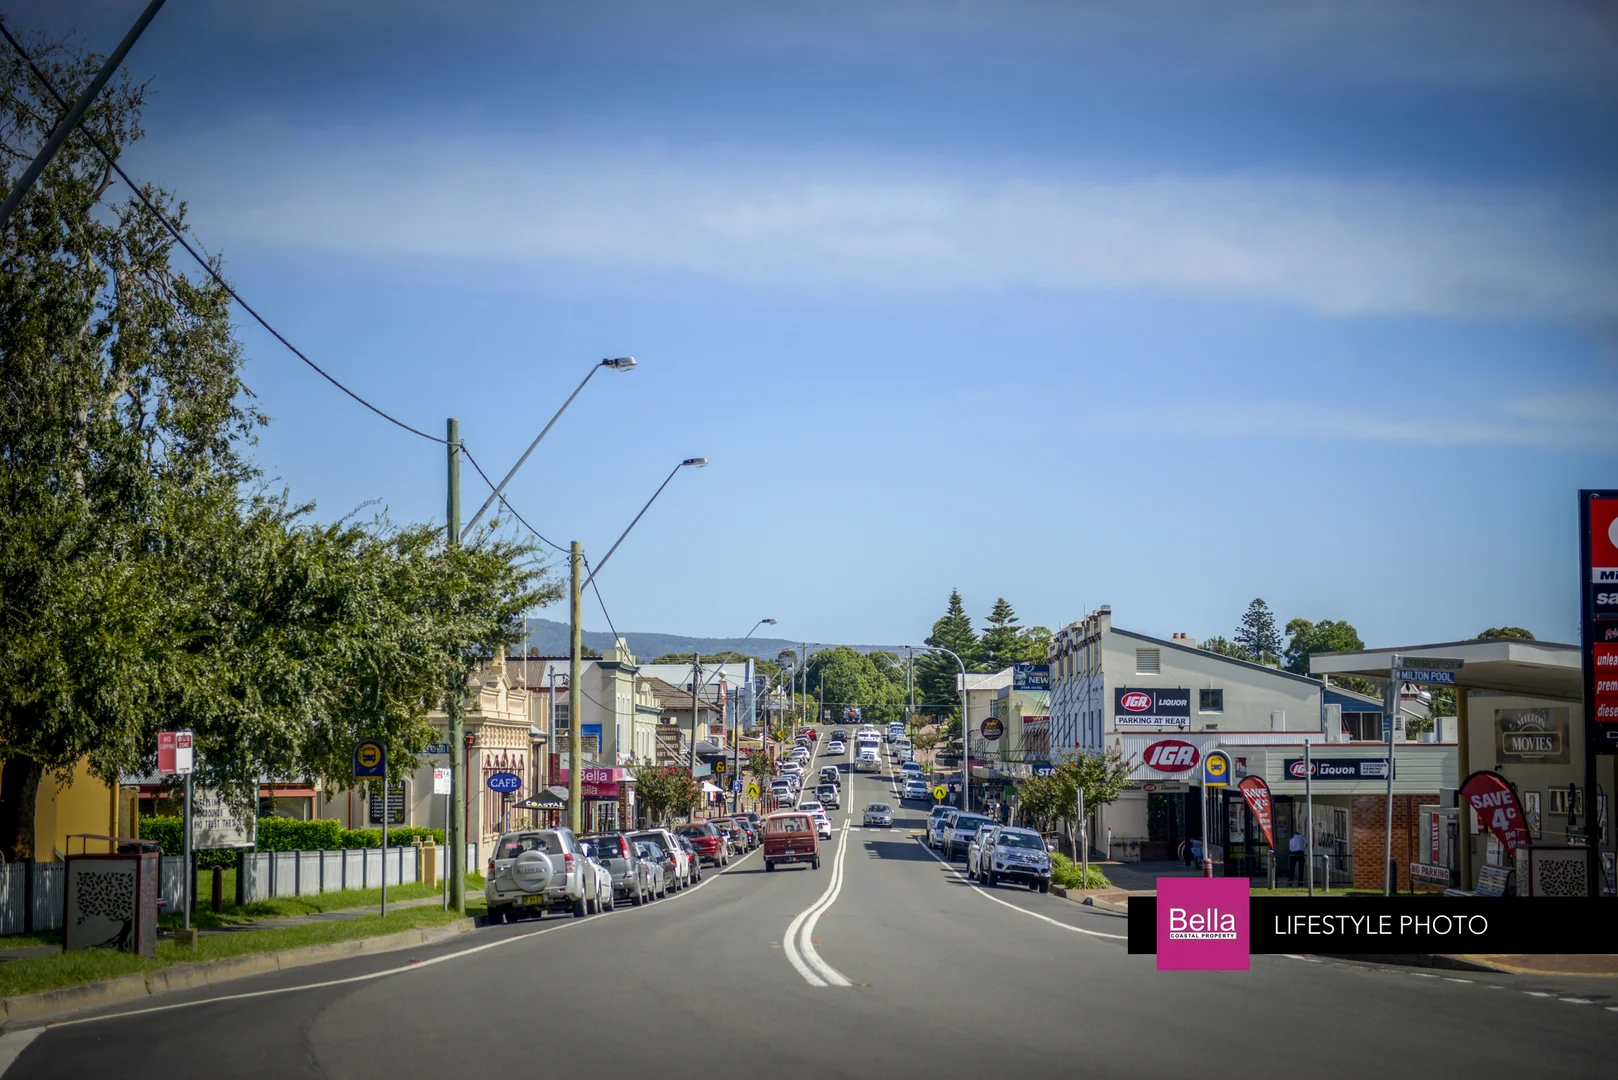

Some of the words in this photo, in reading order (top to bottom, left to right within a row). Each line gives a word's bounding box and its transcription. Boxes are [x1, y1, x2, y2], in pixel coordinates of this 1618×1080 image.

[1401, 671, 1429, 680] MILTON
[1431, 672, 1452, 681] POOL
[1125, 696, 1148, 707] IGA
[1517, 713, 1546, 728] MILTON
[1512, 736, 1552, 751] MOVIES
[1149, 746, 1195, 765] IGA
[1320, 767, 1355, 775] LIQUOR
[581, 785, 597, 795] ella
[1243, 788, 1267, 797] SAVE
[1471, 791, 1513, 808] SAVE
[1411, 865, 1420, 874] NO
[1421, 866, 1449, 879] PARKING
